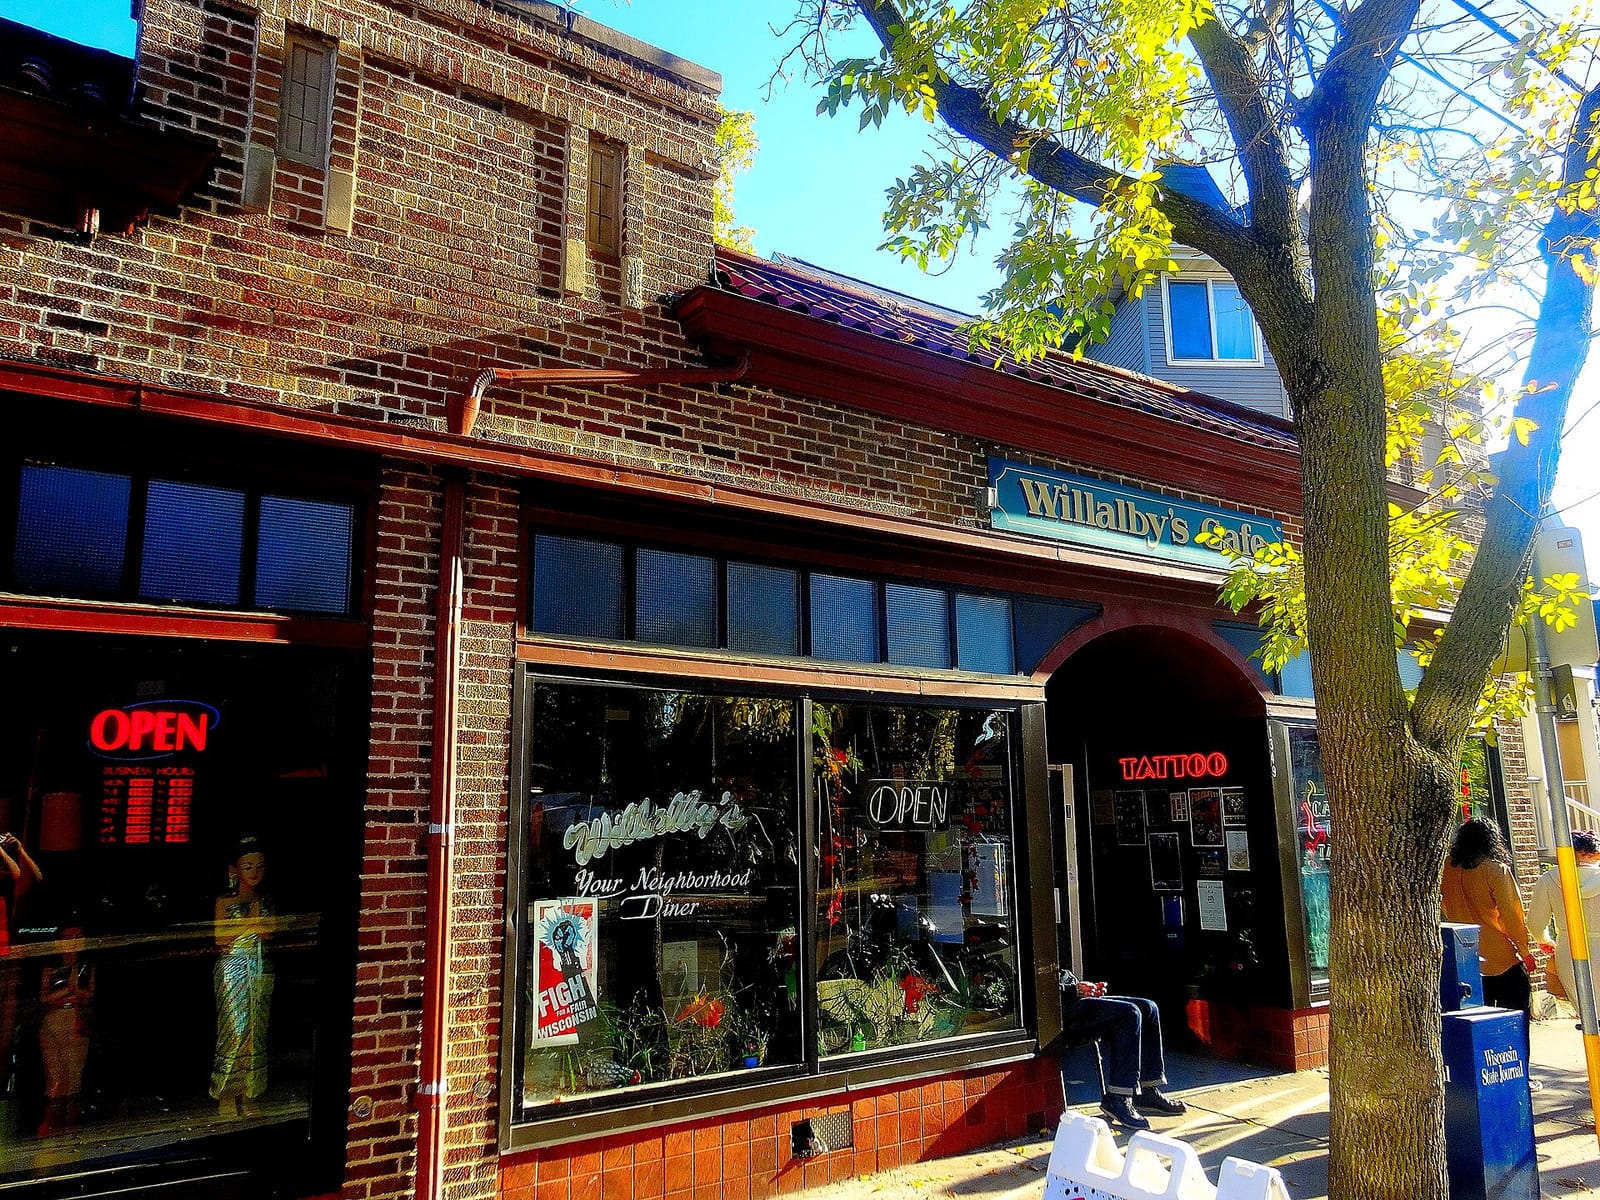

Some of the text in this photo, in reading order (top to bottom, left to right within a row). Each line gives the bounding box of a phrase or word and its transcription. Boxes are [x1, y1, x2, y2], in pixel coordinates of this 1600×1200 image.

[1019, 477, 1267, 557] Willalby's Cafe
[91, 709, 208, 752] OPEN
[103, 766, 195, 776] BUSINESS HOURS
[1119, 752, 1229, 781] TATTOO
[869, 785, 948, 824] OPEN
[575, 867, 751, 900] Your Neighborhood
[619, 894, 700, 921] Diner
[569, 999, 588, 1014] FAIR
[537, 1006, 598, 1039] WISCONSIN
[1483, 1045, 1519, 1067] Wisconsin
[1481, 1060, 1525, 1086] State Journal
